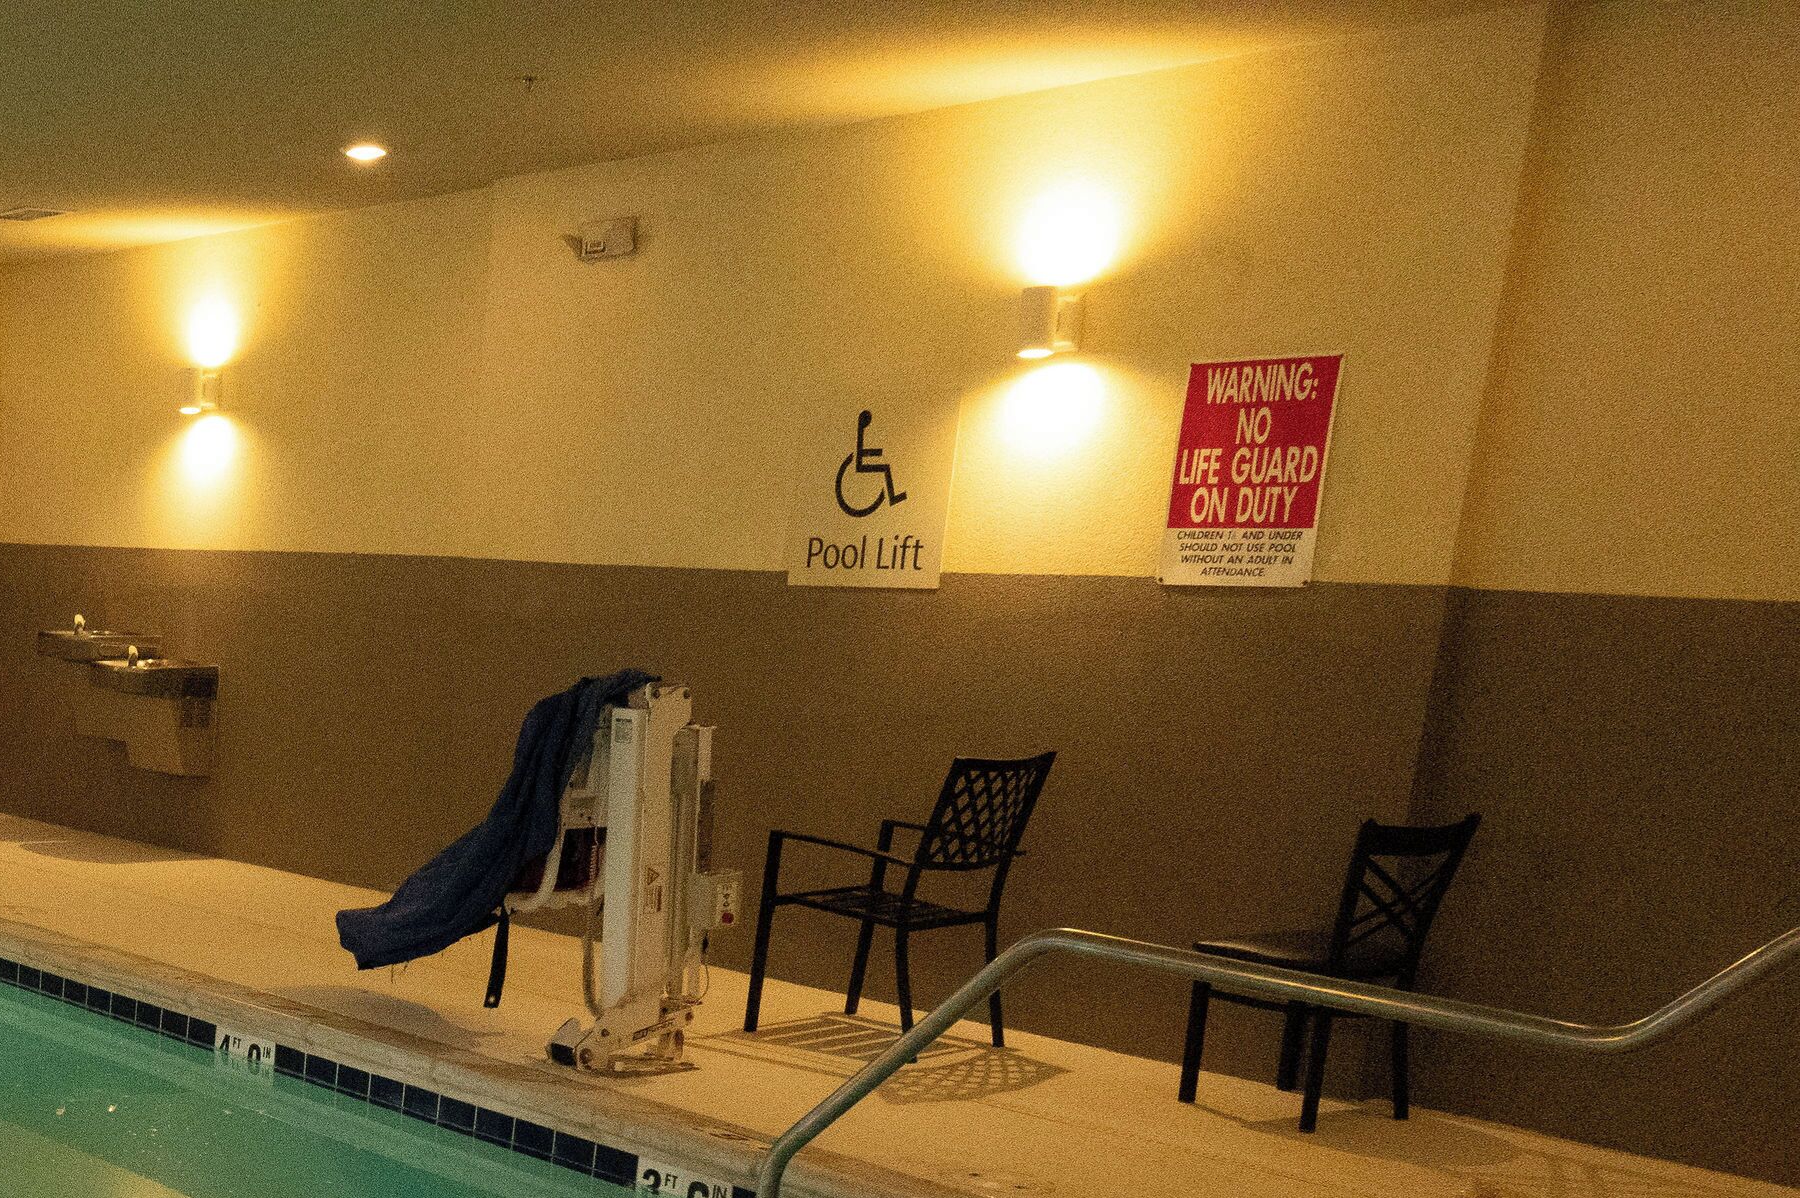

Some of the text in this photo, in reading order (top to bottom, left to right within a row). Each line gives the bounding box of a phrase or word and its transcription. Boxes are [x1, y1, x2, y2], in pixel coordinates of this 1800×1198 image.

[1206, 362, 1319, 405] WARNING:
[1235, 406, 1272, 445] NO
[1179, 445, 1319, 485] LIFE GUARD
[1190, 485, 1299, 524] ON DUTY
[805, 534, 925, 571] Pool Lift
[1176, 530, 1224, 541] CHILDREN
[1241, 530, 1265, 541] AND
[1267, 530, 1304, 541] UNDER
[1179, 542, 1297, 553] SHOULD NOT USE POOL
[1180, 554, 1295, 565] WITHOUT AN ADULT IN
[664, 1173, 679, 1190] FT
